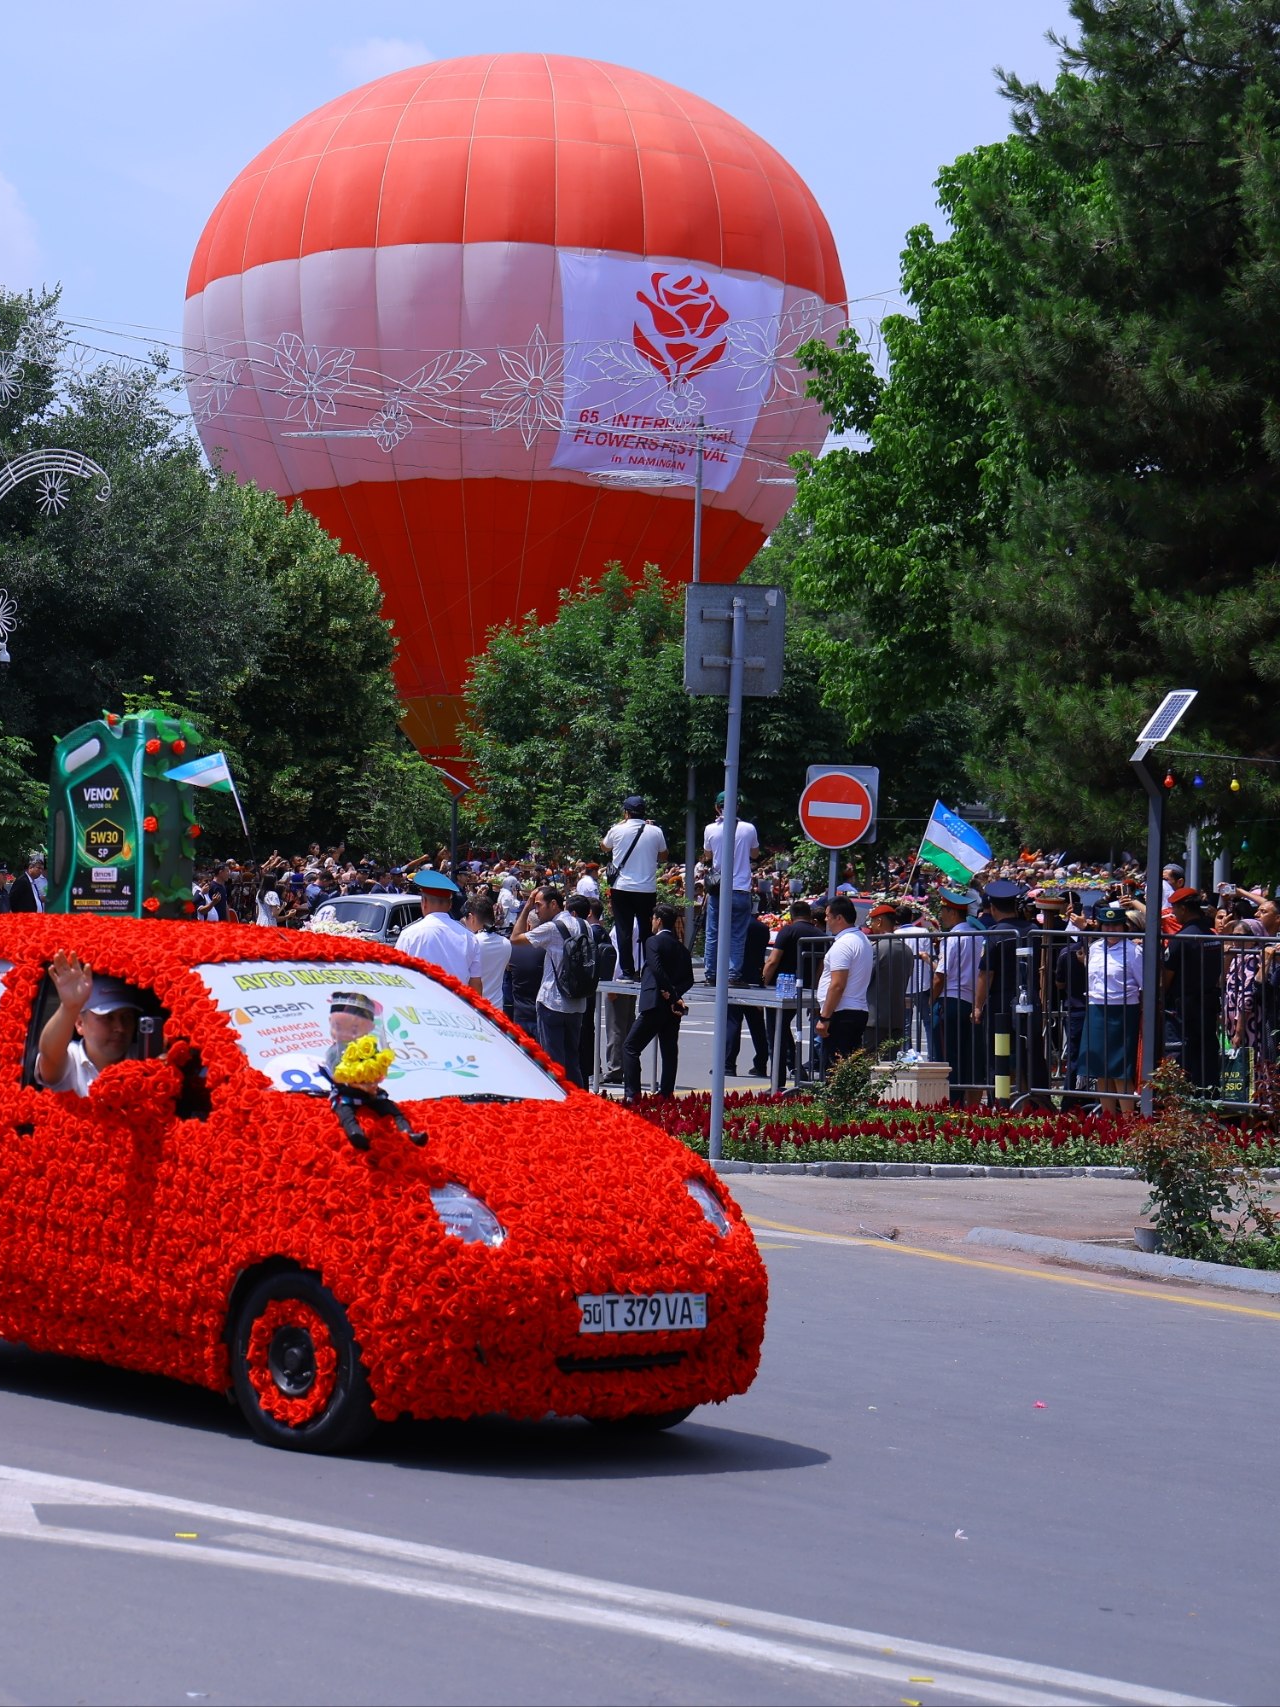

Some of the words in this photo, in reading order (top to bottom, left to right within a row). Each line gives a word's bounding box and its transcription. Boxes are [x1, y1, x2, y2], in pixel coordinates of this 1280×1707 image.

[580, 409, 599, 424] 65
[573, 428, 659, 451] FLOWERS
[661, 438, 728, 463] FESTVAL
[611, 454, 622, 464] in
[83, 787, 119, 801] VENOX
[90, 831, 118, 844] 5W30
[97, 848, 109, 858] SP
[121, 885, 131, 895] 4L
[232, 971, 294, 991] AVTO
[288, 969, 381, 986] MASTER
[245, 1001, 315, 1018] Rosan
[271, 1031, 323, 1044] XALQARO
[583, 1303, 602, 1325] 50
